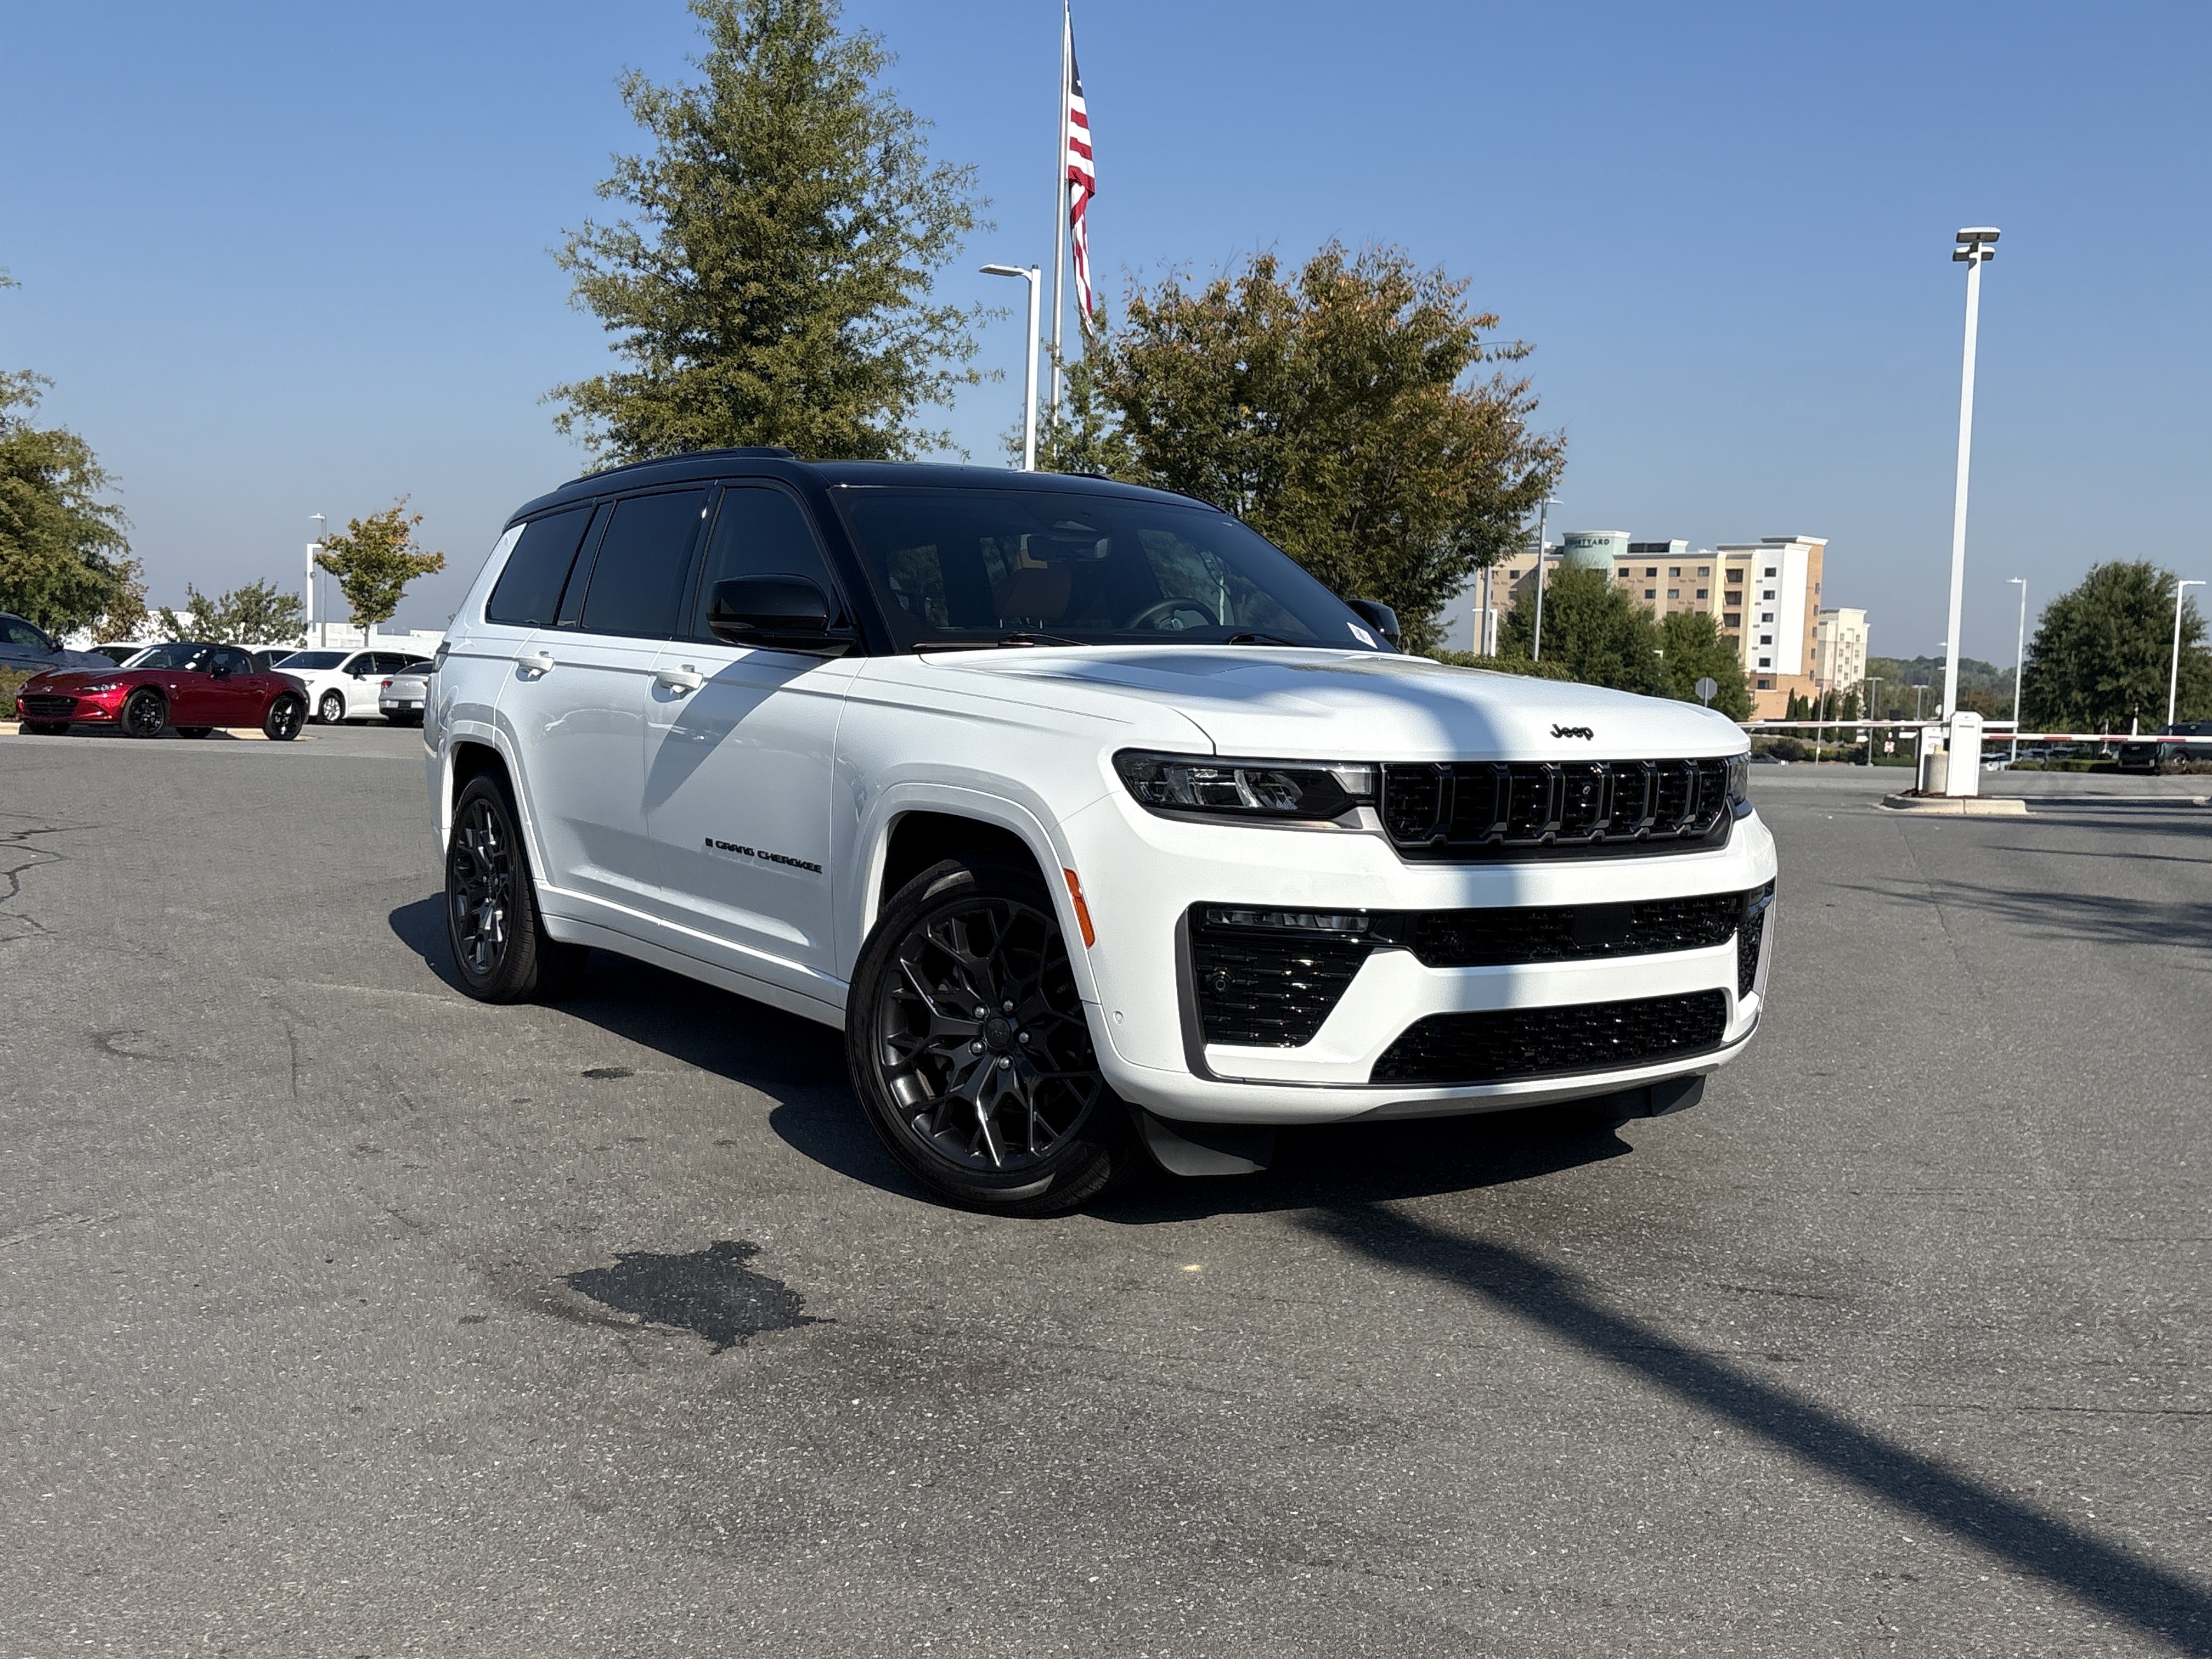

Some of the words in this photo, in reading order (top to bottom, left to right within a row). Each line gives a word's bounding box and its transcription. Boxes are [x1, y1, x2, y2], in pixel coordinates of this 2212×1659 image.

[1549, 724, 1594, 741] Jeep
[715, 840, 755, 857] GRAND
[757, 850, 822, 874] CHEROKEE
